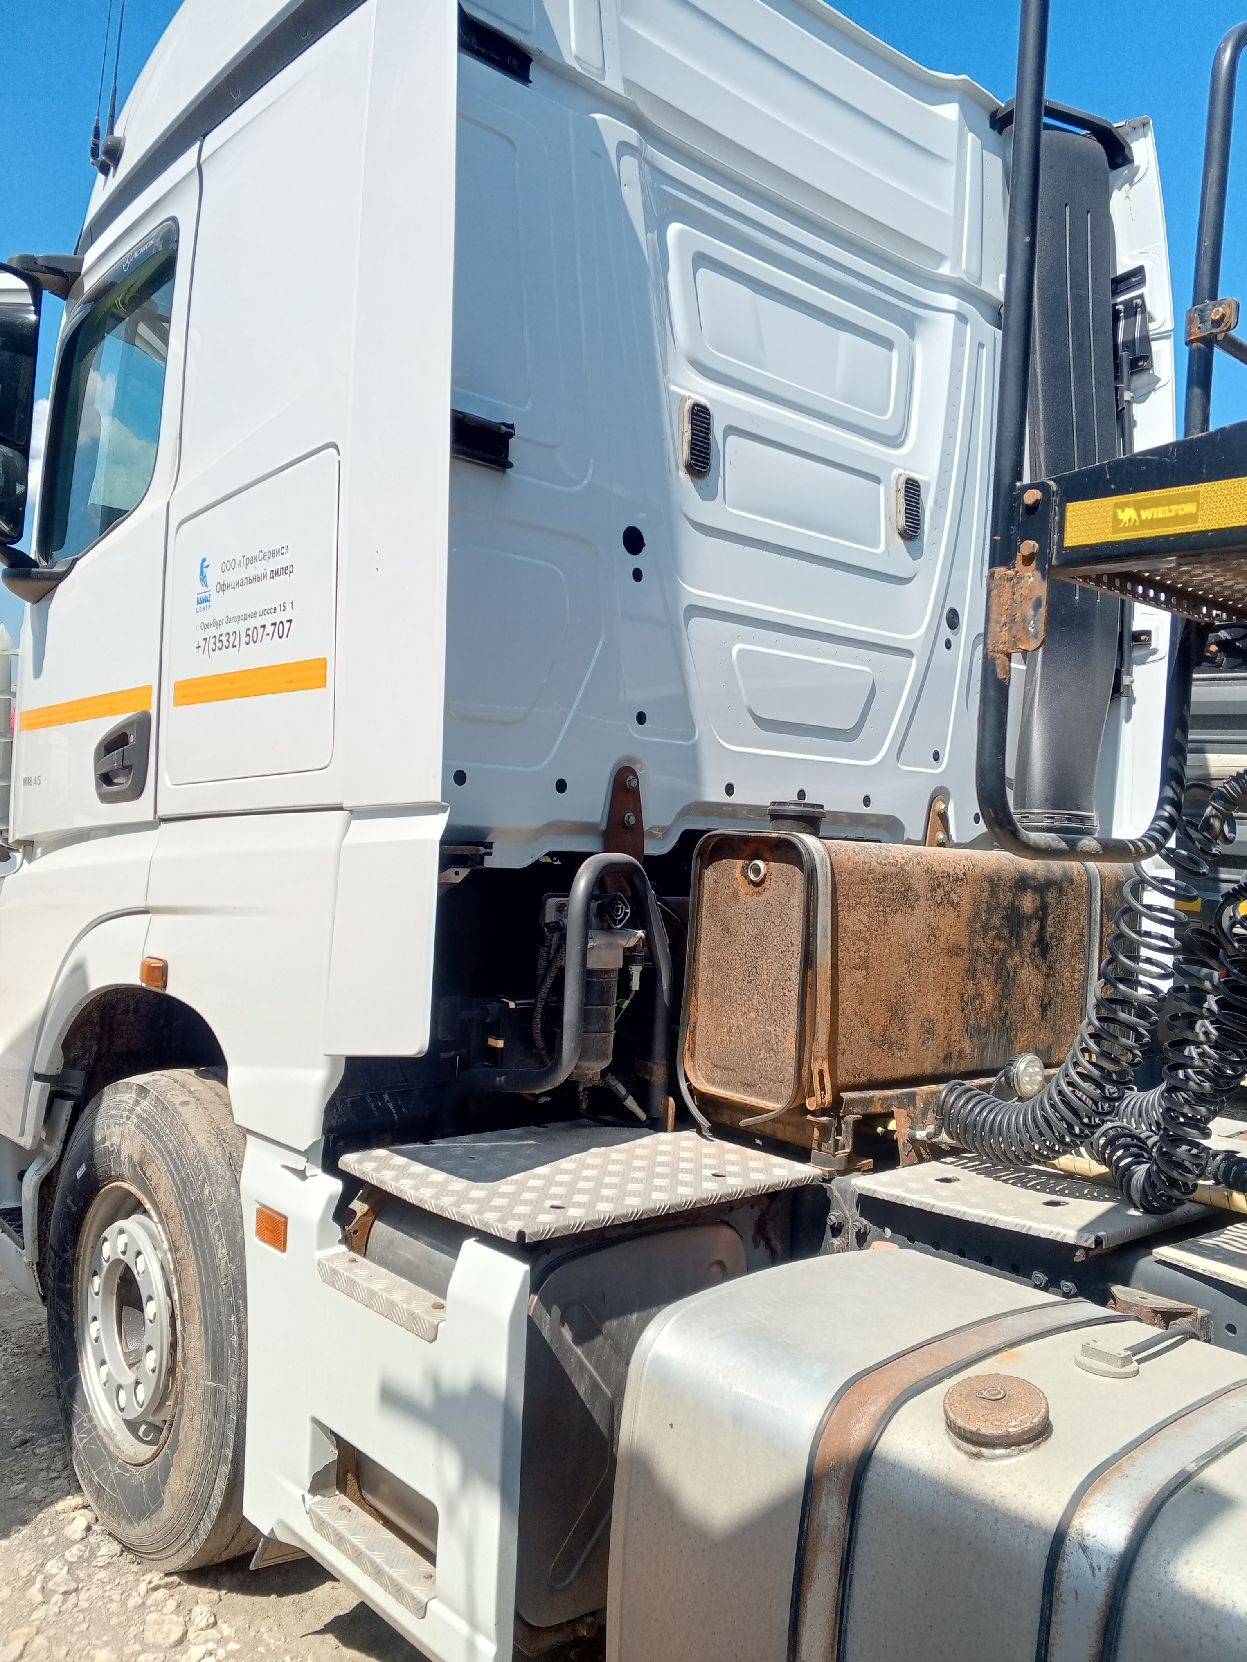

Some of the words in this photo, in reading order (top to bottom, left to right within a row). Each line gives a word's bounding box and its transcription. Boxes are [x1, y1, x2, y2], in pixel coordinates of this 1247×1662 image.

[1140, 502, 1197, 520] WIELTON
[215, 568, 268, 595] Официальный
[269, 564, 294, 580] дилер
[258, 606, 278, 617] шоссе
[195, 630, 241, 658] +7(3532)
[244, 619, 293, 646] 507-707
